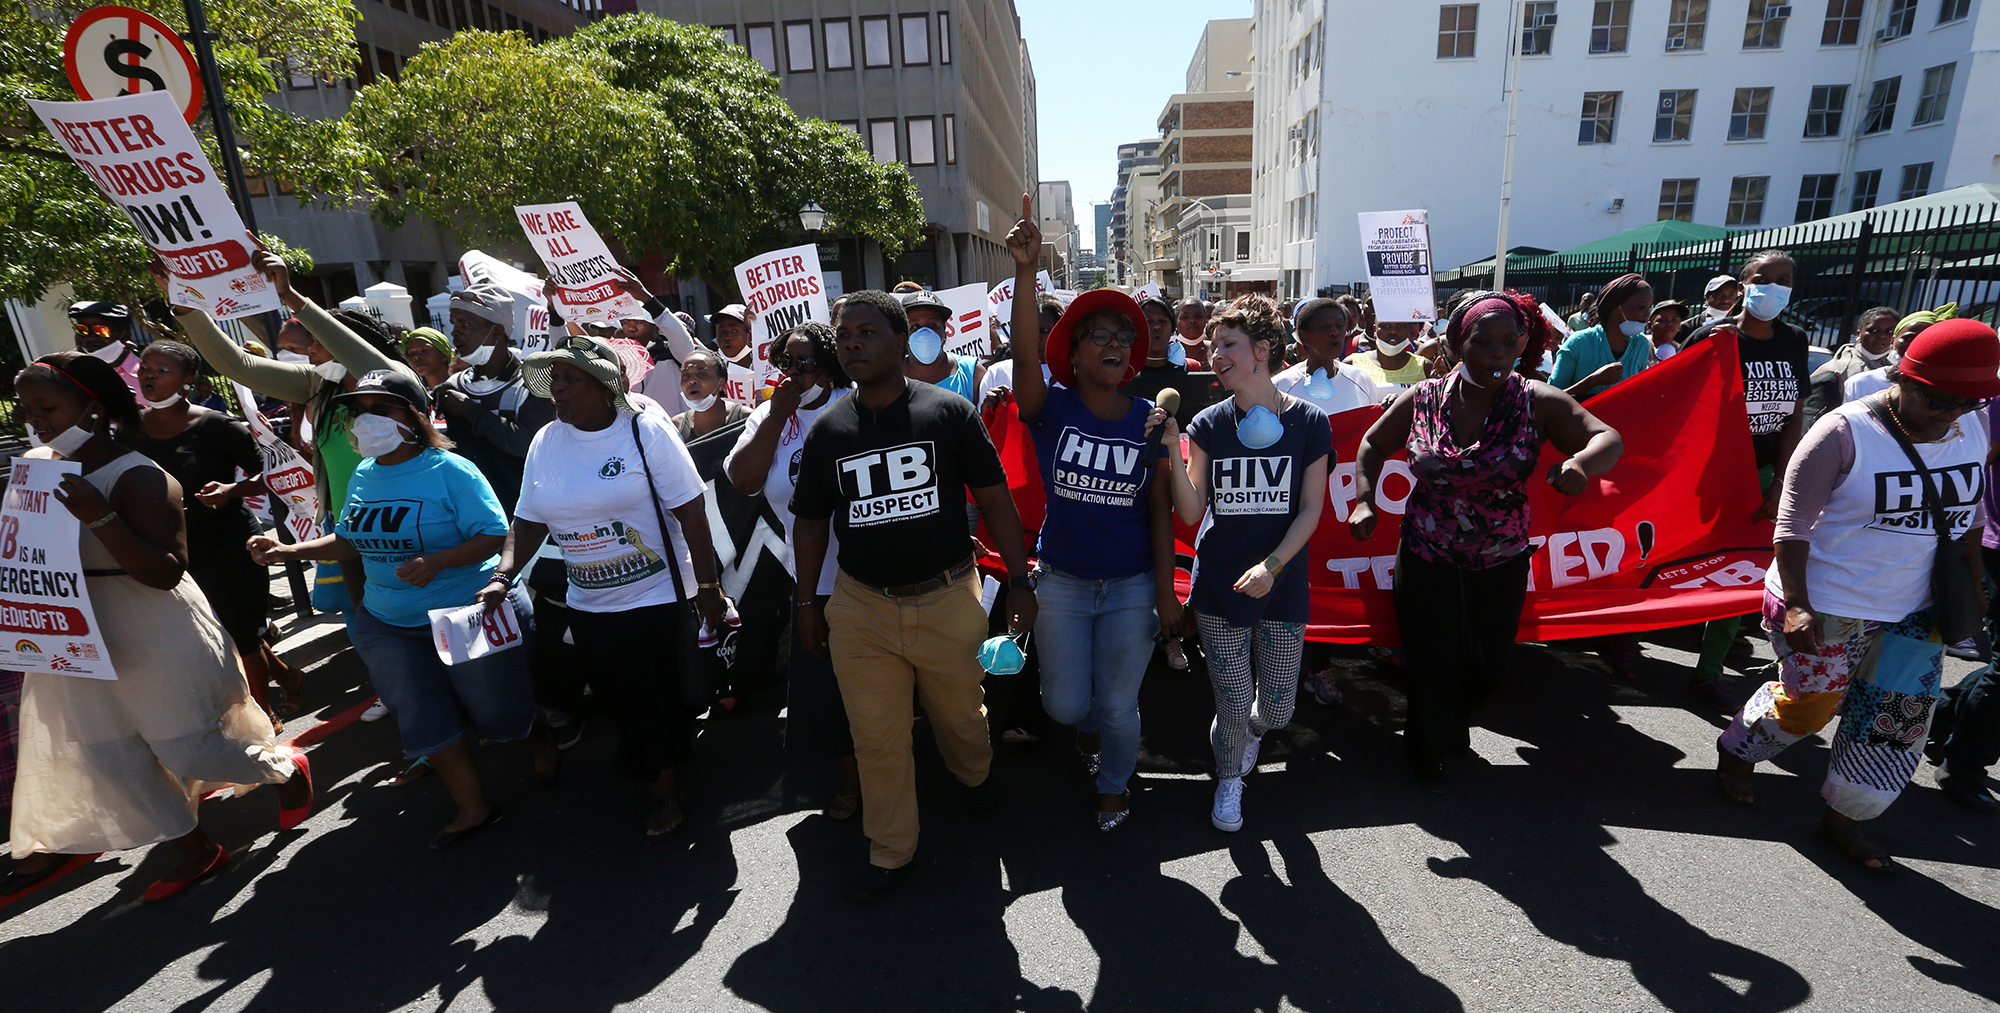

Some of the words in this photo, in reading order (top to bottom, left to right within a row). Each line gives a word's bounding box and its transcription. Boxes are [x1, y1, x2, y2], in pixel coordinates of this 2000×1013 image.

[51, 114, 166, 155] BETTER
[99, 151, 206, 196] DRUGS
[120, 194, 213, 245] OW!
[521, 212, 548, 235] WE
[546, 210, 581, 234] ARE
[1378, 227, 1414, 239] PROTECT
[546, 235, 579, 258] ALL
[1381, 251, 1414, 264] PROVIDE
[562, 254, 613, 285] SUSPECTS
[745, 255, 806, 290] BETTER
[748, 290, 769, 314] TB
[766, 275, 820, 306] DRUGS
[990, 285, 1014, 305] WE
[530, 308, 550, 331] WE
[527, 334, 541, 348] OF
[1745, 361, 1776, 379] XDR
[1776, 361, 1796, 379] TB:
[1743, 390, 1799, 401] ESISTANC
[1748, 380, 1798, 391] EXTREME
[1761, 402, 1782, 412] NEEDS
[1060, 433, 1140, 475] HIV
[842, 447, 931, 498] TB
[1056, 469, 1137, 494] POSITIVE
[1214, 457, 1291, 489] HIV
[852, 490, 935, 519] SUSPECT
[1054, 485, 1081, 501] TREATMENT
[1082, 493, 1106, 504] ACTION
[1106, 496, 1134, 507] CAMPAIGN
[1215, 490, 1289, 504] POSITIVE
[345, 506, 412, 533] HIV
[19, 545, 29, 562] IS
[31, 547, 46, 565] AN
[349, 538, 416, 550] OSITIVE
[620, 569, 651, 583] Dialogues
[1657, 568, 1688, 581] LET'S
[1692, 555, 1726, 571] STOP
[0, 566, 80, 598] ERGENCY
[0, 605, 70, 632] EDIEOFTB
